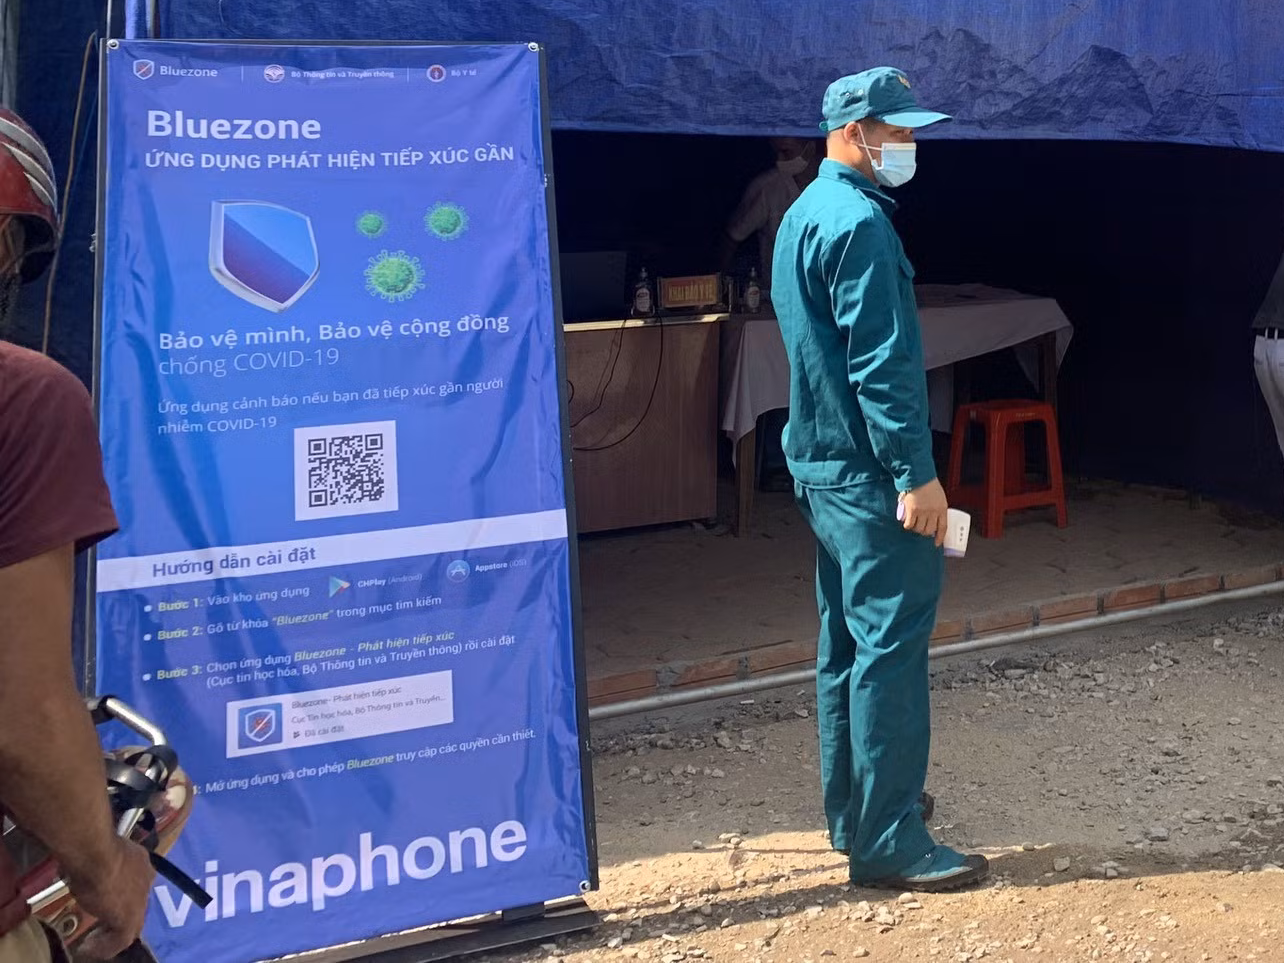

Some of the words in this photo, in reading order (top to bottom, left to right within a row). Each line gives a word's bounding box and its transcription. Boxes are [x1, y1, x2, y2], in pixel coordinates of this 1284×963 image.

[159, 65, 218, 78] Bluezone
[147, 110, 321, 139] Bluezone
[145, 149, 194, 168] ỨNG
[201, 153, 261, 171] DỤNG
[268, 150, 322, 169] PHÁT
[328, 150, 375, 170] HIỆN
[381, 147, 424, 166] TIẾP
[429, 147, 469, 165] XÚC
[474, 143, 514, 161] GẦN
[159, 331, 203, 350] Bảo
[210, 329, 238, 350] vệ
[245, 325, 311, 345] mình,
[319, 321, 361, 340] Bảo
[368, 320, 393, 340] vệ
[400, 318, 450, 338] cộng
[457, 313, 510, 333] đồng
[158, 355, 227, 378] chống
[233, 347, 339, 371] COVID-19
[158, 399, 188, 415] Ứng
[191, 401, 229, 415] dụng
[232, 396, 267, 410] cảnh
[271, 394, 298, 407] báo
[302, 390, 328, 405] nếu
[333, 390, 359, 403] bạn
[362, 387, 380, 401] đã
[383, 384, 409, 401] tiếp
[412, 383, 436, 397] xúc
[439, 380, 463, 398] gần
[466, 378, 504, 395] người
[207, 416, 277, 432] COVID-19
[152, 558, 214, 578] Hướng
[219, 552, 251, 570] dẫn
[256, 552, 283, 567] cài
[287, 546, 317, 563] đặt
[357, 577, 387, 589] CHPlay
[475, 561, 508, 573] Appstore
[158, 599, 189, 612] Bước
[193, 597, 204, 608] 1:
[207, 594, 230, 606] Vào
[233, 591, 253, 603] kho
[255, 589, 278, 602] ứng
[281, 586, 310, 599] dụng
[157, 628, 188, 641] Bước
[192, 626, 203, 636] 2:
[242, 618, 269, 630] khóa
[336, 605, 366, 619] trong
[368, 603, 393, 615] mục
[395, 598, 413, 610] tìm
[416, 595, 442, 608] kiếm
[157, 668, 188, 680] Bước
[191, 665, 202, 675] 3:
[206, 661, 236, 675] Chọn
[239, 656, 262, 669] ứng
[264, 653, 291, 666] dụng
[294, 645, 346, 661] Bluezone
[358, 639, 383, 653] Phát
[386, 635, 410, 649] hiện
[413, 632, 433, 647] tiếp
[436, 630, 455, 643] xúc
[206, 674, 234, 689] (Cục
[236, 671, 251, 682] tin
[253, 669, 275, 682] học
[303, 662, 317, 675] Bộ
[320, 656, 355, 672] Thông
[358, 654, 372, 666] tin
[374, 652, 387, 664] và
[390, 646, 426, 662] Truyền
[428, 642, 463, 658] thông)
[465, 639, 479, 651] rồi
[481, 636, 496, 648] cài
[498, 635, 516, 647] đặt
[206, 780, 225, 794] Mở
[227, 776, 248, 790] ứng
[250, 772, 280, 787] dụng
[282, 769, 294, 780] và
[297, 766, 316, 779] cho
[318, 760, 345, 777] phép
[347, 754, 395, 770] Bluezone
[396, 748, 416, 763] truy
[418, 745, 438, 760] cập
[439, 741, 457, 754] các
[459, 737, 490, 753] quyền
[492, 731, 511, 745] cần
[155, 820, 527, 928] vinaphone
